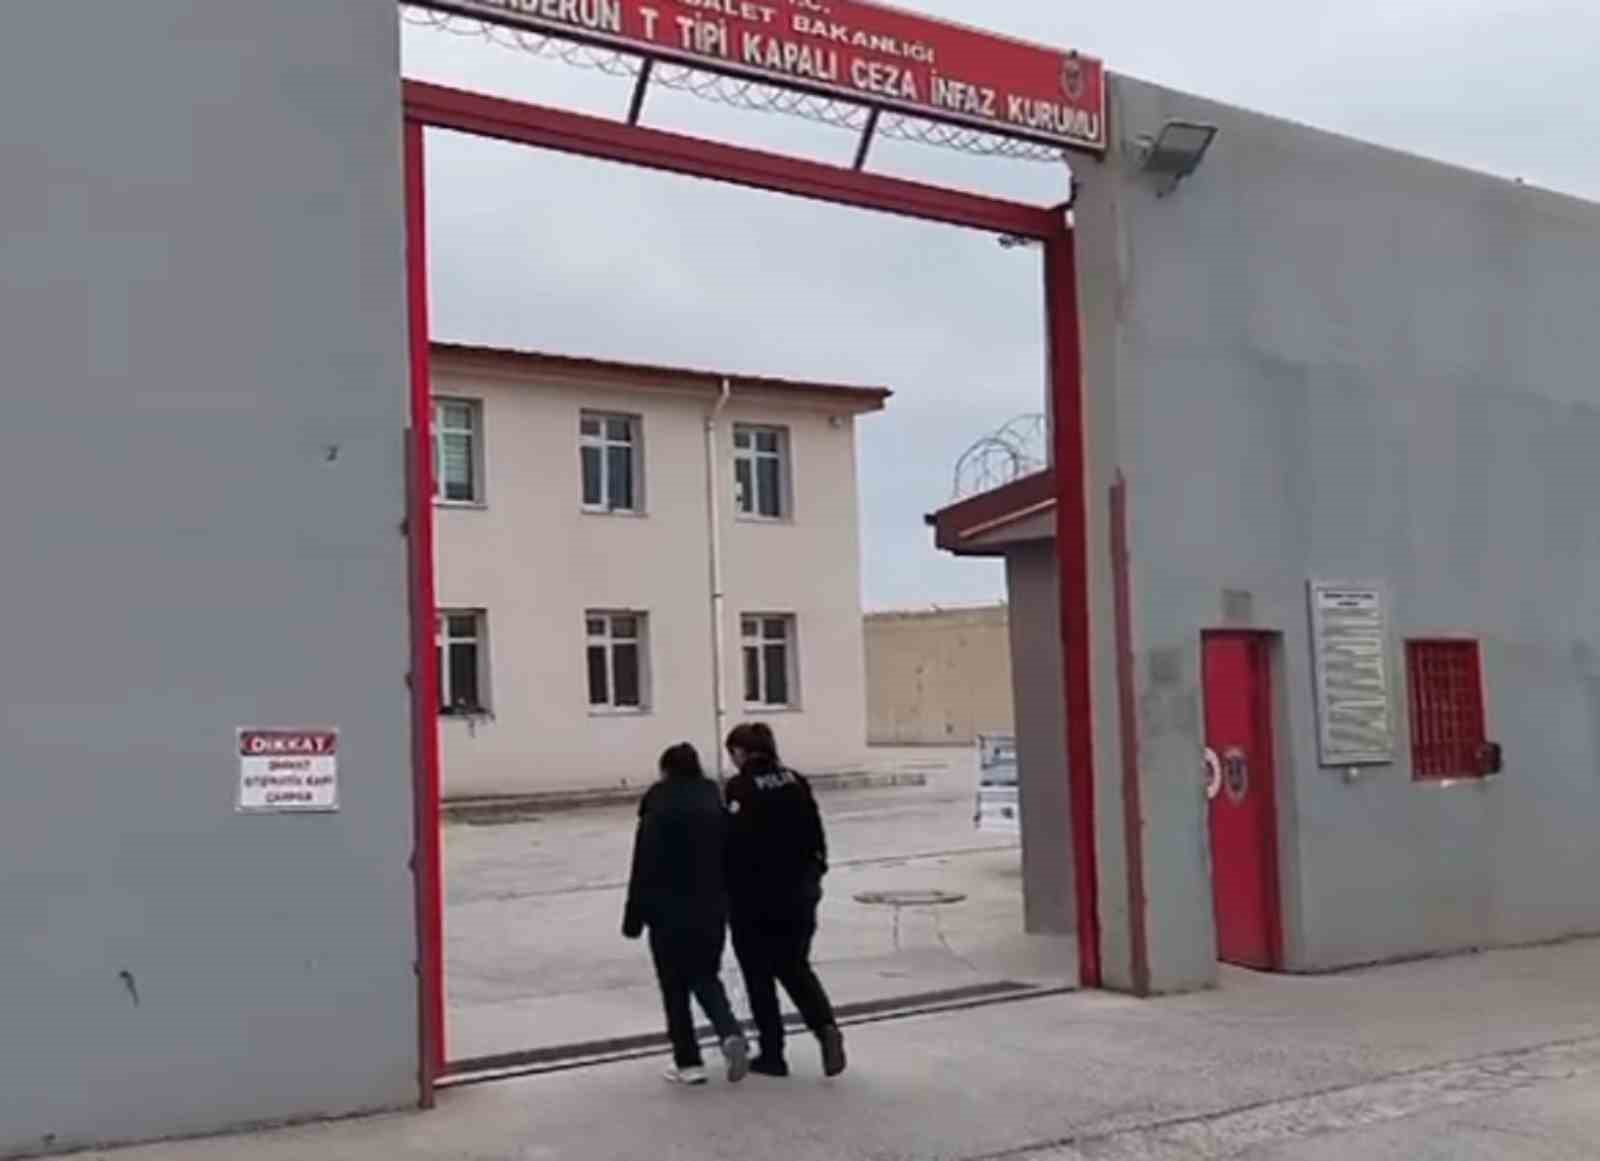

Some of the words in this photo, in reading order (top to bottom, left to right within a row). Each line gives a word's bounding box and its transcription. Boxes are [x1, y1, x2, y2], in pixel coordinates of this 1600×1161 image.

[638, 6, 659, 39] T
[675, 11, 728, 58] TİPİ
[742, 31, 839, 81] KAPALI
[850, 58, 919, 100] CEZA
[929, 68, 997, 118] İNFAZ
[1006, 92, 1099, 141] KURUMU
